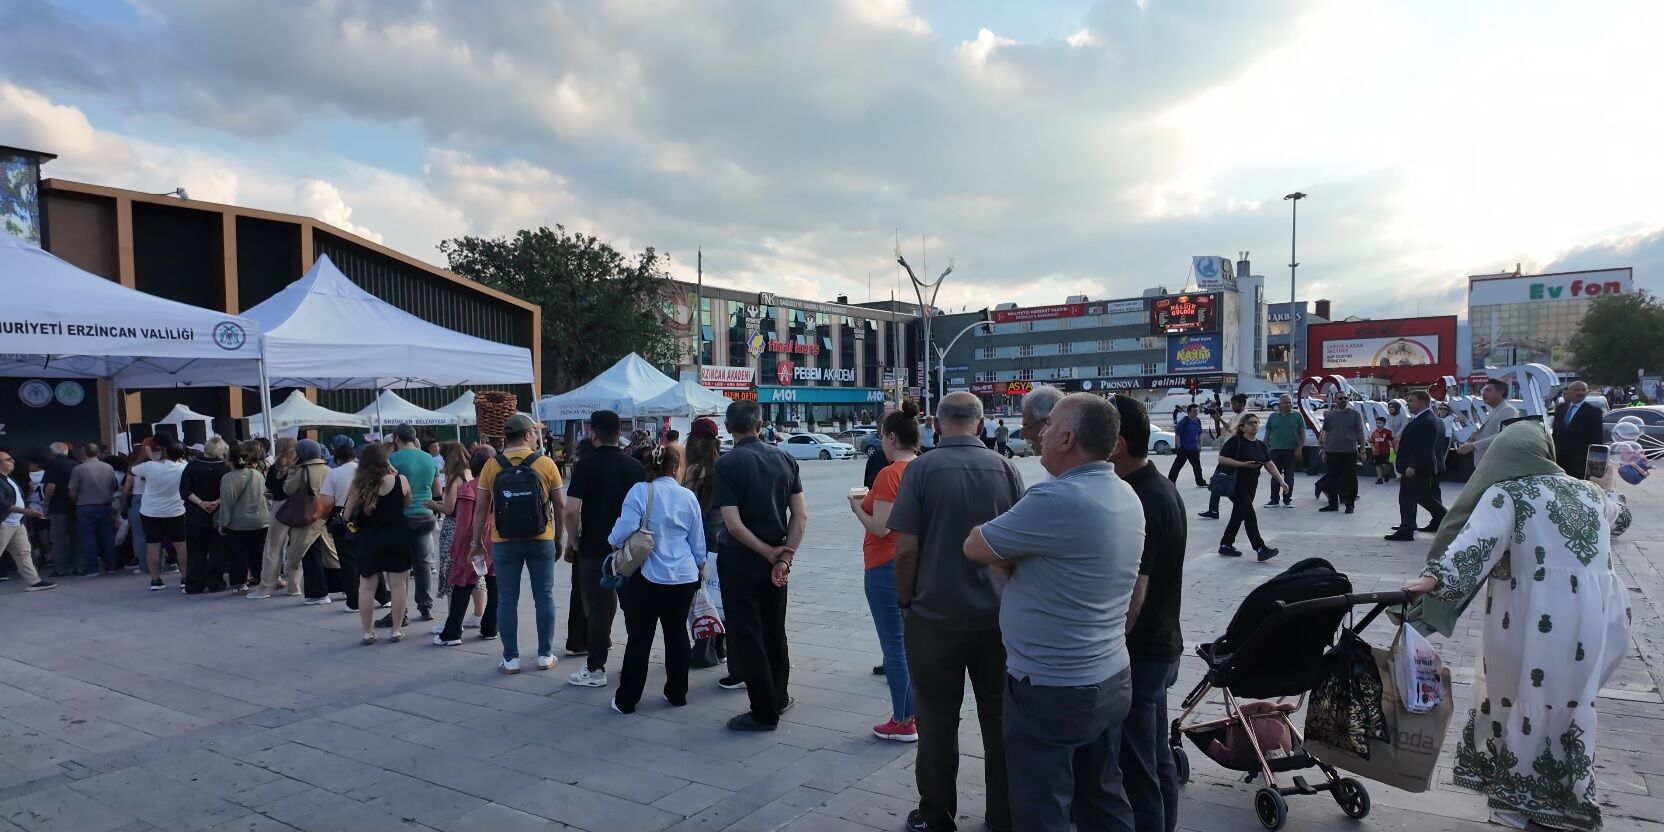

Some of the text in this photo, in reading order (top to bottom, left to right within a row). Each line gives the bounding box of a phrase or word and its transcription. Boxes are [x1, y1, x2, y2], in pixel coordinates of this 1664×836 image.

[1530, 280, 1620, 299] Ev fon
[67, 323, 137, 338] ERZİNCAN
[140, 327, 194, 341] VALİLİĞİ
[768, 339, 819, 355] final kurs
[701, 368, 726, 380] RZİNCAN
[794, 366, 821, 380] PEGEM
[824, 367, 854, 381] AKADEMİ
[1008, 381, 1033, 391] ASYA
[1101, 379, 1140, 389] PRONOVA
[1151, 377, 1187, 388] gelinlik
